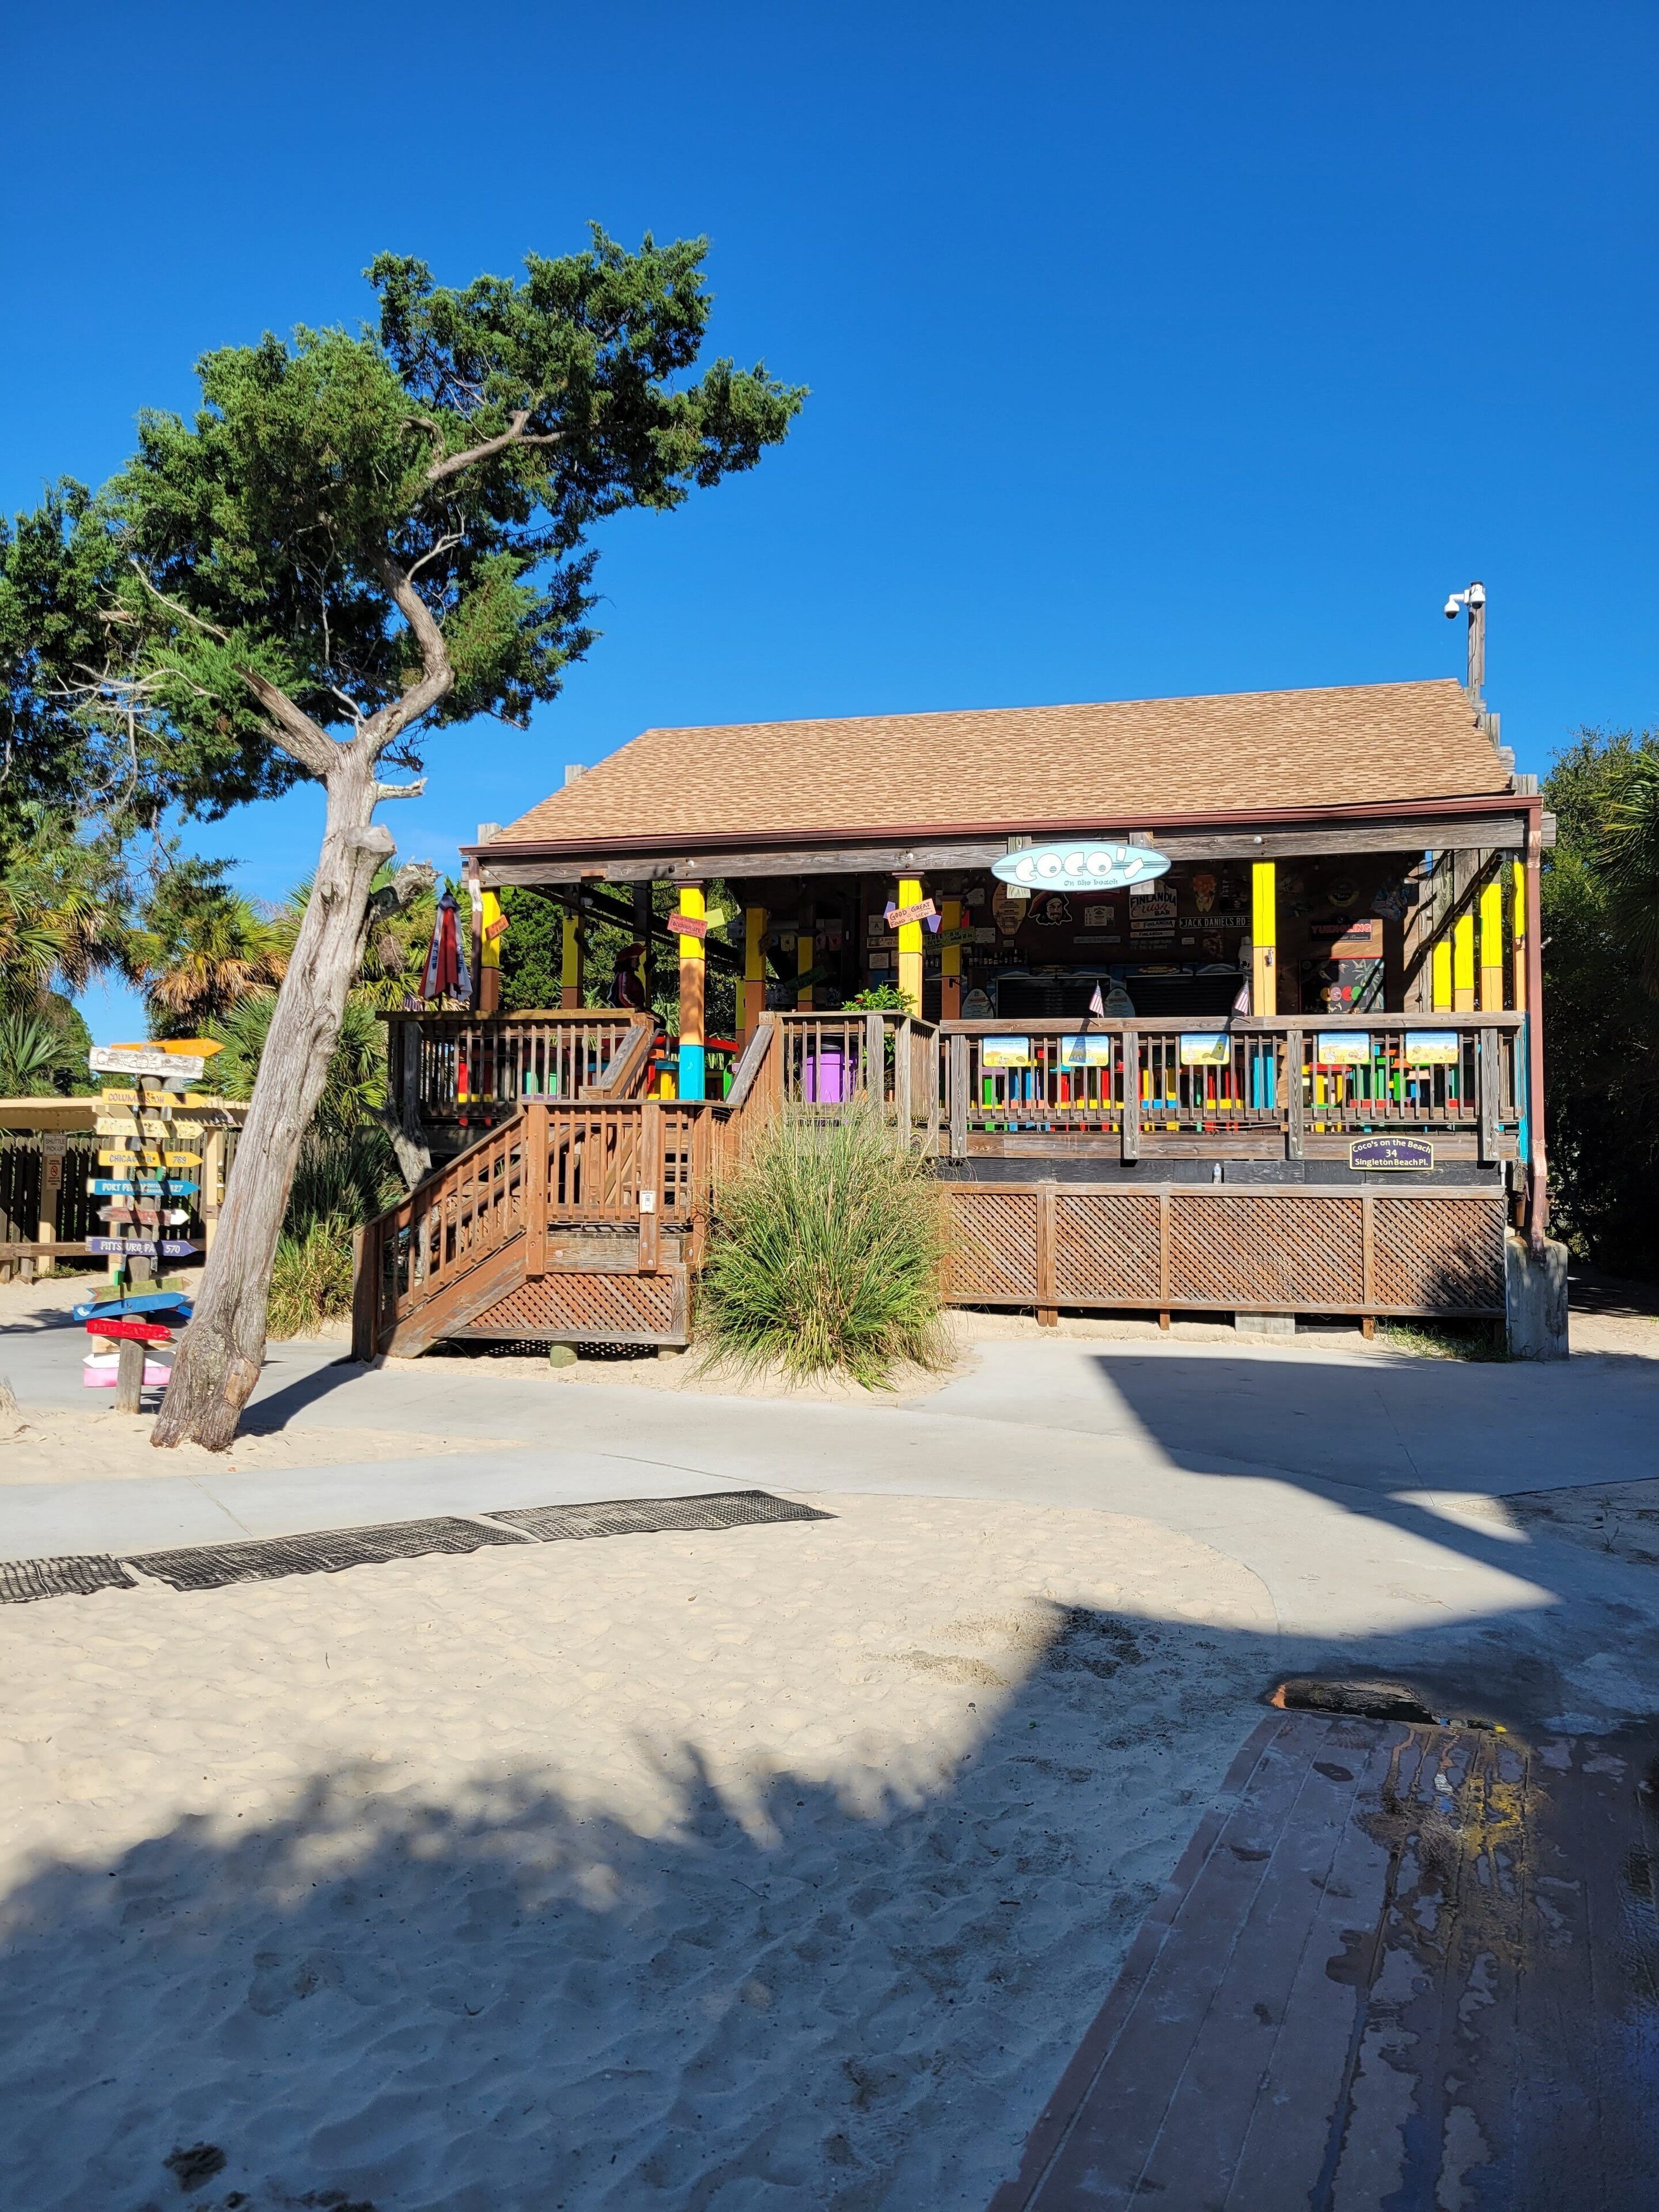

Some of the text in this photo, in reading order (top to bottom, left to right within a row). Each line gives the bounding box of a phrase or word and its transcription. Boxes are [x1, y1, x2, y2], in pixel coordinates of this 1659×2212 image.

[1131, 892, 1176, 907] FINLANDIA
[890, 902, 930, 921] GOOD GREAT
[891, 919, 905, 927] FOOD
[1183, 917, 1246, 927] JACK DANIEL'S RD
[154, 1094, 164, 1103] OH
[1353, 1141, 1378, 1153] Coco's
[1408, 1141, 1431, 1154] Beach
[1385, 1149, 1397, 1157] 34
[1355, 1158, 1393, 1167] Singleton
[103, 1183, 122, 1191] PORT
[100, 1241, 180, 1253] PITTSURG, PA 570
